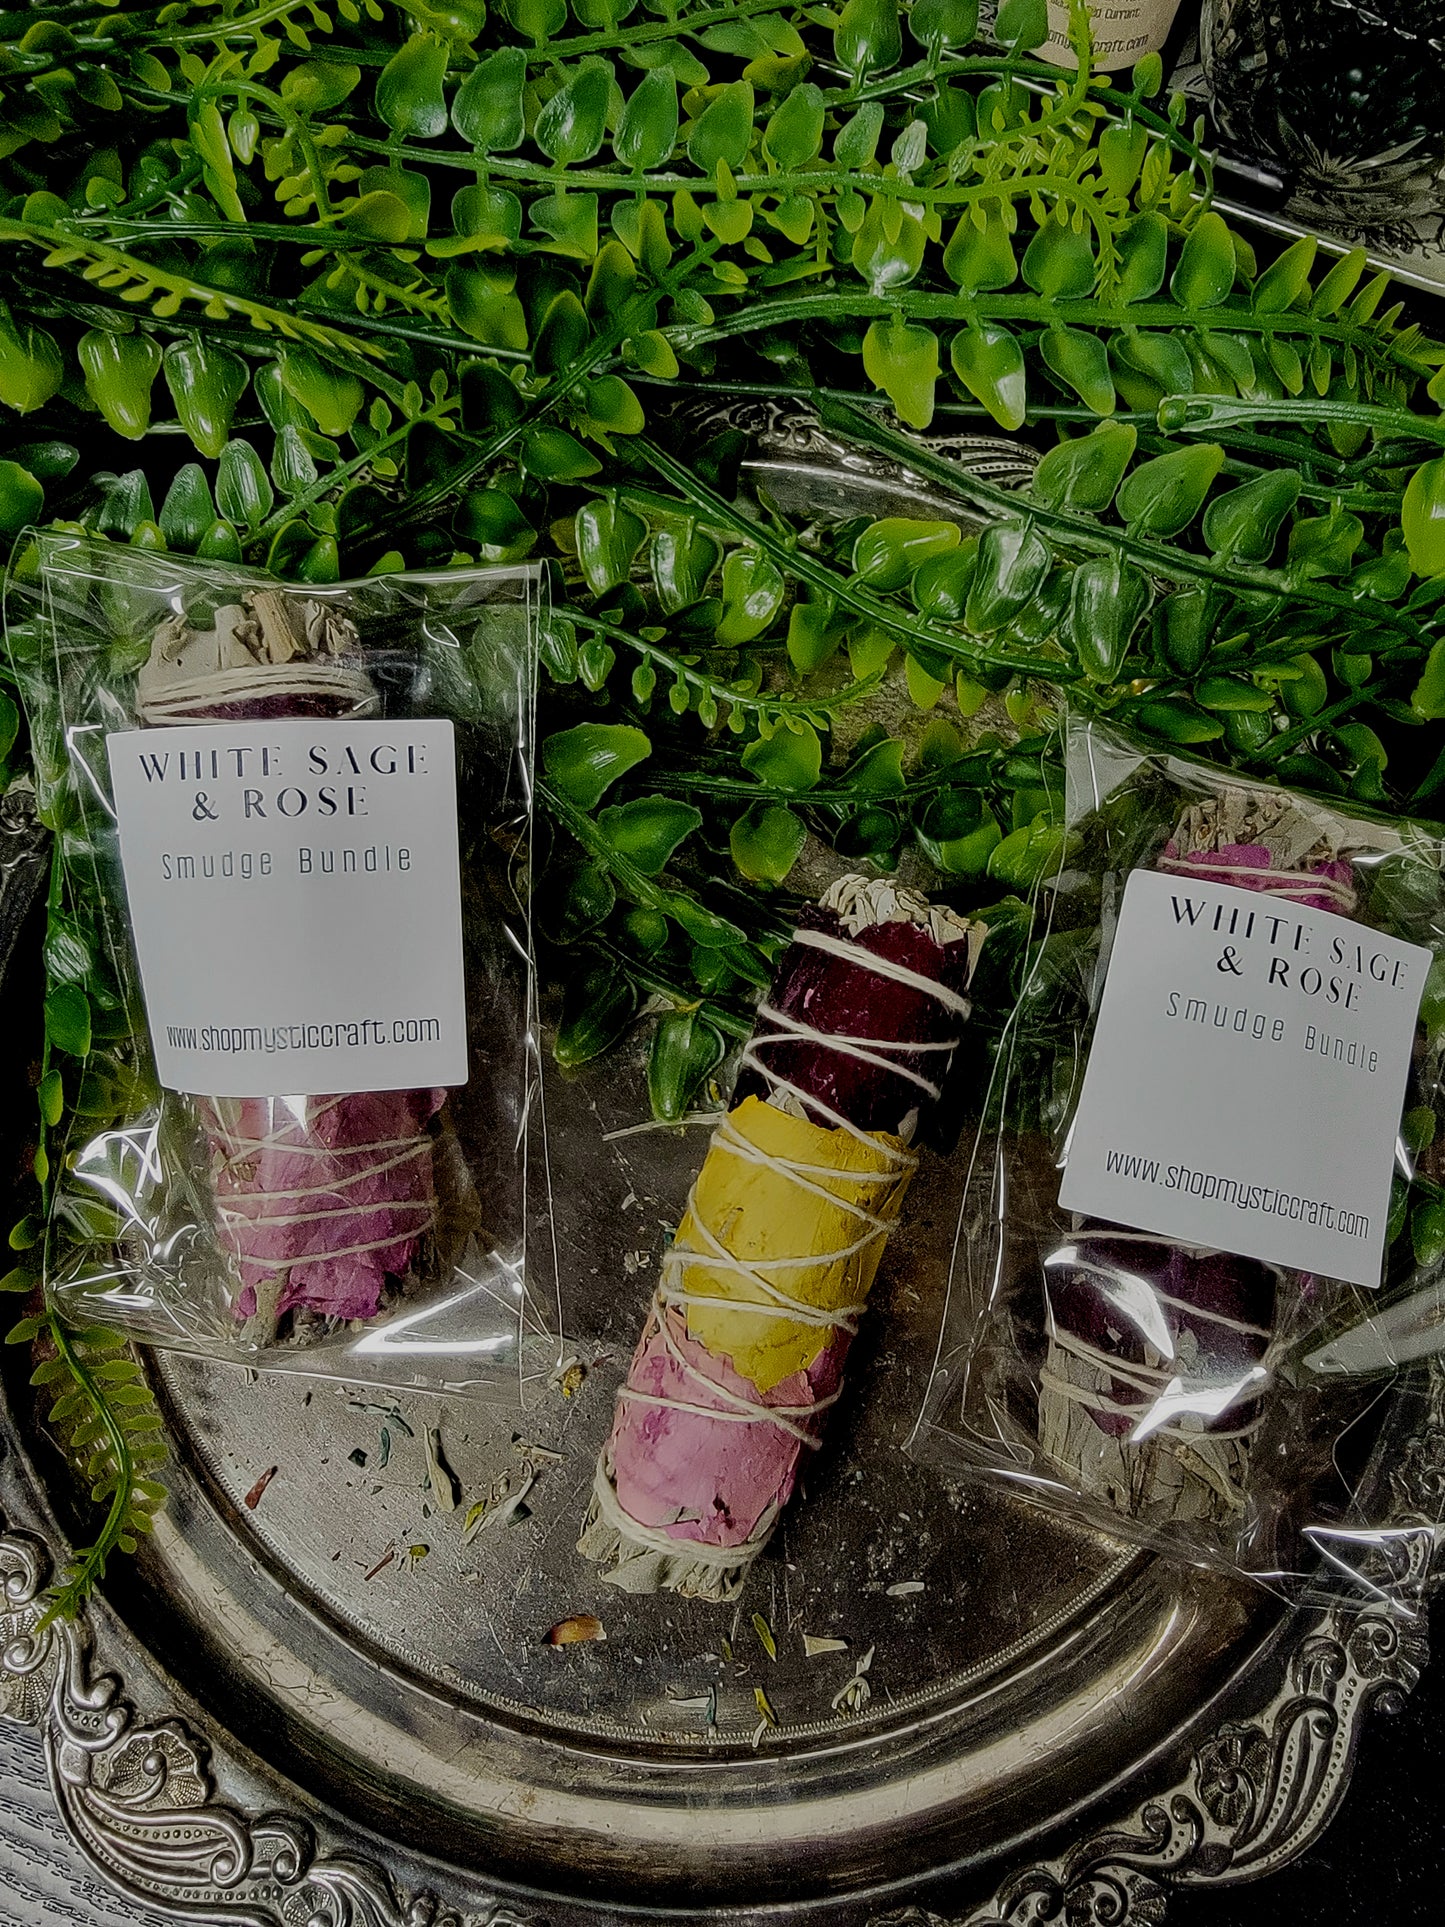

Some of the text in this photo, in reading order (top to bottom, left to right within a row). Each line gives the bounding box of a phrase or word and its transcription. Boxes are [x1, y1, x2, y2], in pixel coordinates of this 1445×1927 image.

[138, 743, 430, 783] WHITE SAGE
[191, 785, 370, 822] & ROSE
[161, 846, 413, 881] Smudge Bundle
[1170, 895, 1410, 991] WHITE SAGE
[1216, 945, 1362, 1013] & ROSE
[166, 1017, 441, 1054] www.shopmysticcraft.com
[1166, 991, 1379, 1074] Smudge Bundle
[1105, 1149, 1370, 1240] www.shopmysticcraft.com
